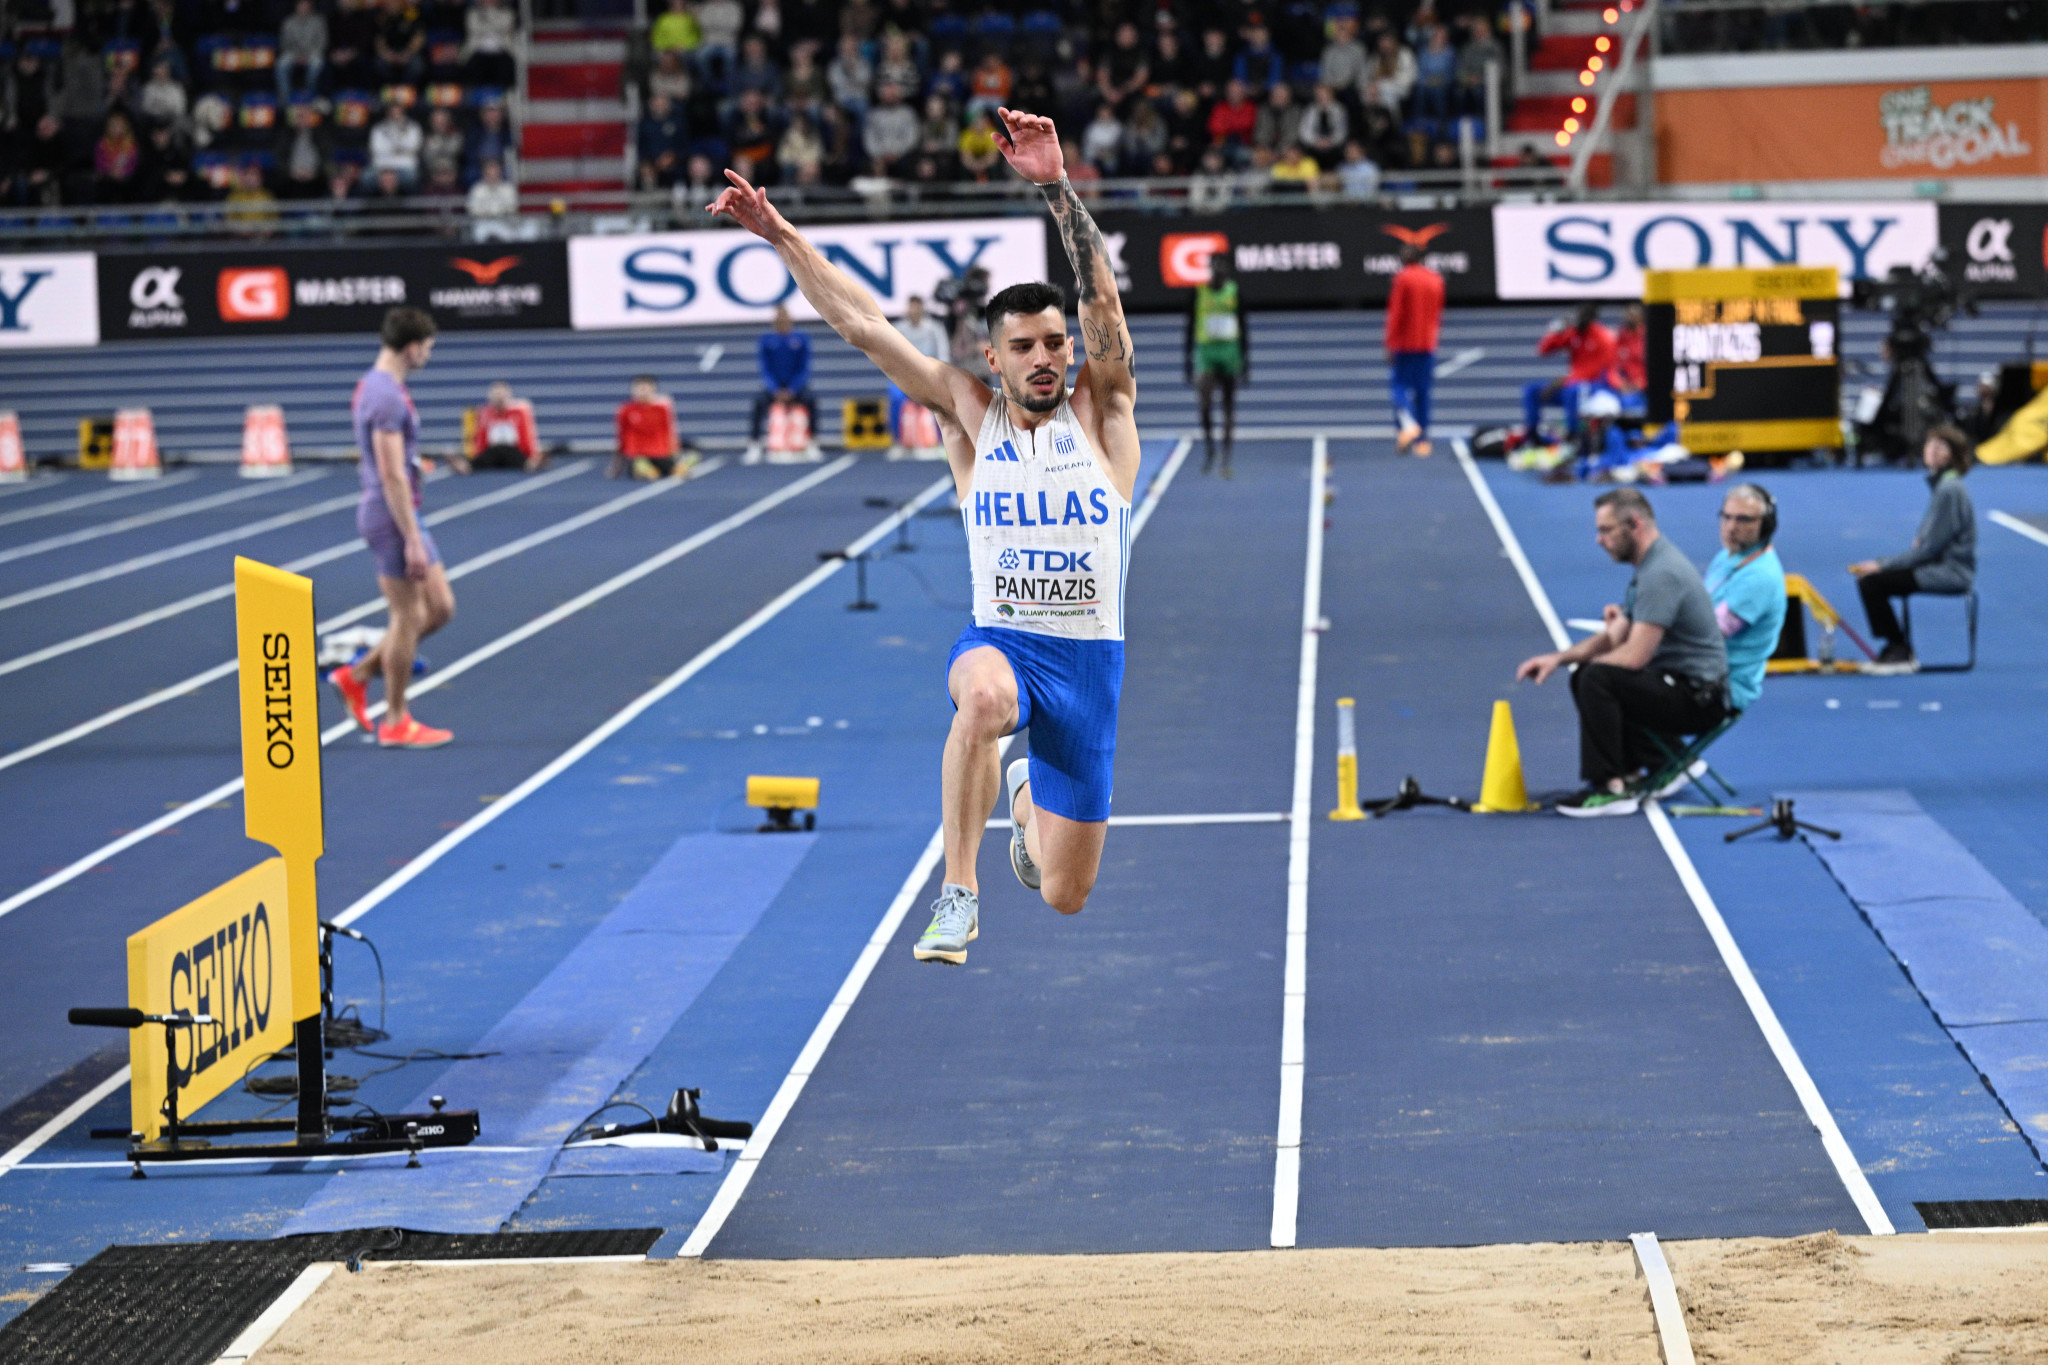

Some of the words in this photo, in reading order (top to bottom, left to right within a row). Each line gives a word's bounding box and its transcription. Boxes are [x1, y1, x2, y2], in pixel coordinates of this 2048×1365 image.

[1929, 121, 2032, 169] GOAL
[1234, 242, 1342, 271] MASTER
[1544, 215, 1900, 285] SONY
[623, 234, 1003, 314] SONY
[227, 271, 279, 317] G
[295, 276, 407, 305] MASTER
[1045, 461, 1084, 473] AEGEAN
[975, 488, 1109, 526] HELLAS
[1020, 549, 1093, 572] TDK
[995, 575, 1096, 601] PANTAZIS
[1019, 609, 1049, 617] KUJAWY
[1050, 609, 1085, 617] POMORZE
[263, 632, 294, 769] SEIKO
[170, 901, 272, 1089] SEIKO
[416, 1124, 445, 1136] EIKO
